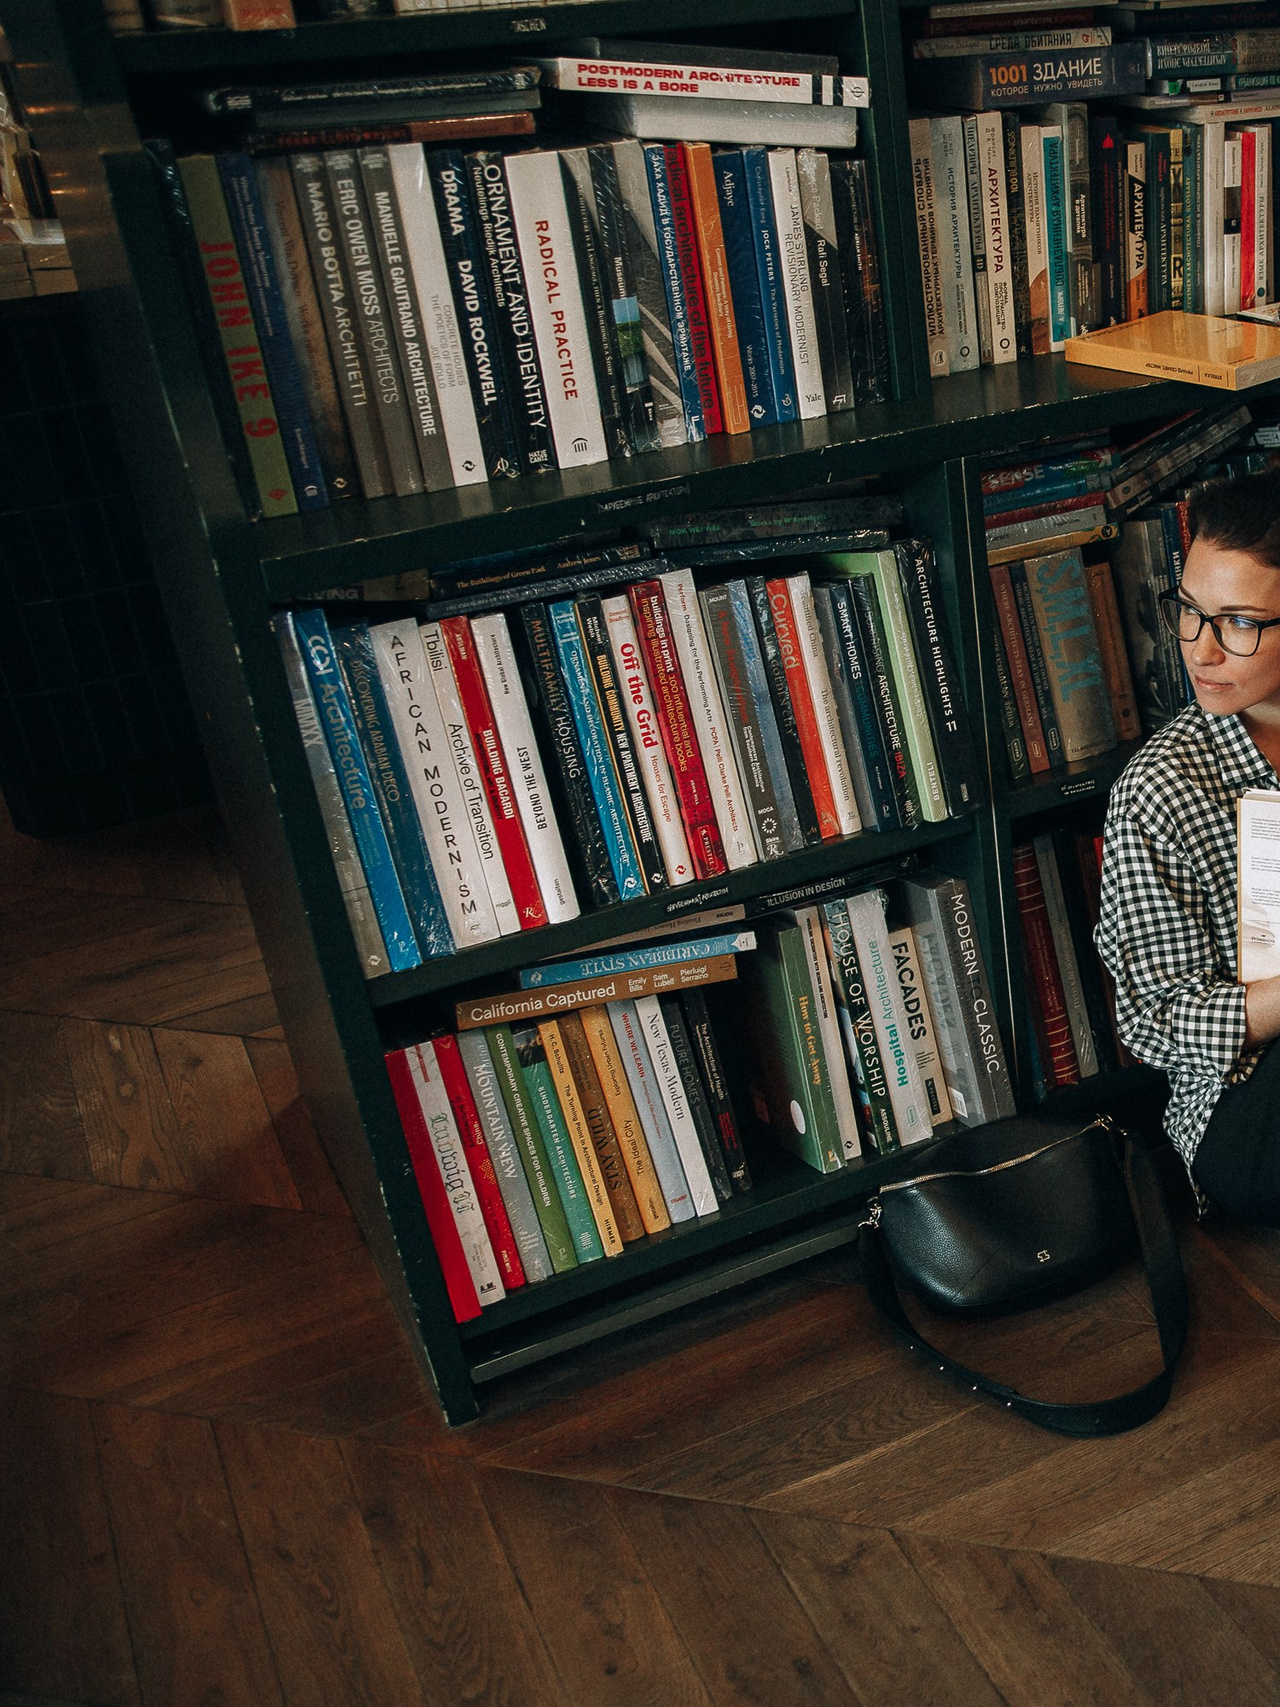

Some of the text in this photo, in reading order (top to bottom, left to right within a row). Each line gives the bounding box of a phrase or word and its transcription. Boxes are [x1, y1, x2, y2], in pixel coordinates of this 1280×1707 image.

[511, 19, 547, 33] TASCHEN
[989, 33, 1072, 50] СРЕДА ОБИТАНИЯ
[577, 63, 801, 88] POSTMODERN ARCHITECTURE
[577, 77, 699, 93] LESS IS A BORE
[989, 57, 1102, 85] 1001 ЗДАНИЕ
[991, 79, 1103, 97] КОТОРОЕ НУЖНО УВИДЕТЬ
[336, 178, 360, 216] ERIC
[966, 126, 983, 251] ШЕДЕВРЫ АРХИТЕКТУРЫ
[1048, 141, 1060, 208] АРХИТЕКТУРА
[345, 217, 370, 268] OWEN
[914, 157, 937, 337] ИЛЛЮСТРИРОВАННЫЙ СЛОВАРЬ
[987, 167, 1005, 274] АРХИТЕКТУРА
[1133, 183, 1146, 270] АРХИТЕКТУРА
[306, 181, 333, 243] MARIO
[321, 246, 345, 304] BOTTA
[334, 305, 367, 407] ARCHITETTI
[356, 270, 381, 318] MOSS
[374, 190, 438, 438] MANUELLE GAUTRAND ARCHITECTURE
[441, 169, 498, 407] DRAMA DAVID ROCKWELL
[483, 163, 548, 429] ORNAMENT AND IDENTITY
[534, 220, 580, 401] RADICAL PRACTICE
[784, 233, 810, 366] REVISIONARY MODERNIST
[367, 318, 399, 405] ARCHITECTS
[987, 465, 1045, 490] SENSE
[769, 593, 800, 670] Curved
[1000, 583, 1011, 610] WHERE
[1005, 613, 1021, 657] ARCHITECTS
[424, 630, 448, 674] Tbilisi
[641, 597, 688, 772] inspiring illustrated architecture books
[1015, 657, 1023, 679] STAY
[530, 619, 581, 779] MULTIFAMILY HOUSING
[620, 643, 658, 750] Off the Grid
[1021, 691, 1034, 727] GERMANY
[320, 683, 366, 810] Architecture
[391, 634, 477, 916] AFRICAN MODERNISM
[482, 729, 515, 820] BUILDING BACARDI
[448, 723, 495, 861] Archive of Transition
[518, 747, 547, 829] BEYOND THE WEST
[470, 982, 616, 1022] California Captured
[628, 977, 647, 986] Emily
[653, 973, 668, 982] Sam
[654, 978, 675, 988] Lubell
[680, 966, 707, 977] Pierluigi
[680, 971, 709, 981] Serraino
[831, 911, 887, 1098] HOUSE OF WORSHIP
[891, 941, 928, 1042] FACADES
[869, 940, 909, 1088] Hospital Architecture
[647, 1013, 685, 1121] New Texas Modern
[495, 1033, 552, 1208] CONTEMPORARY CREATIVE SPACES FOR CHILDREN
